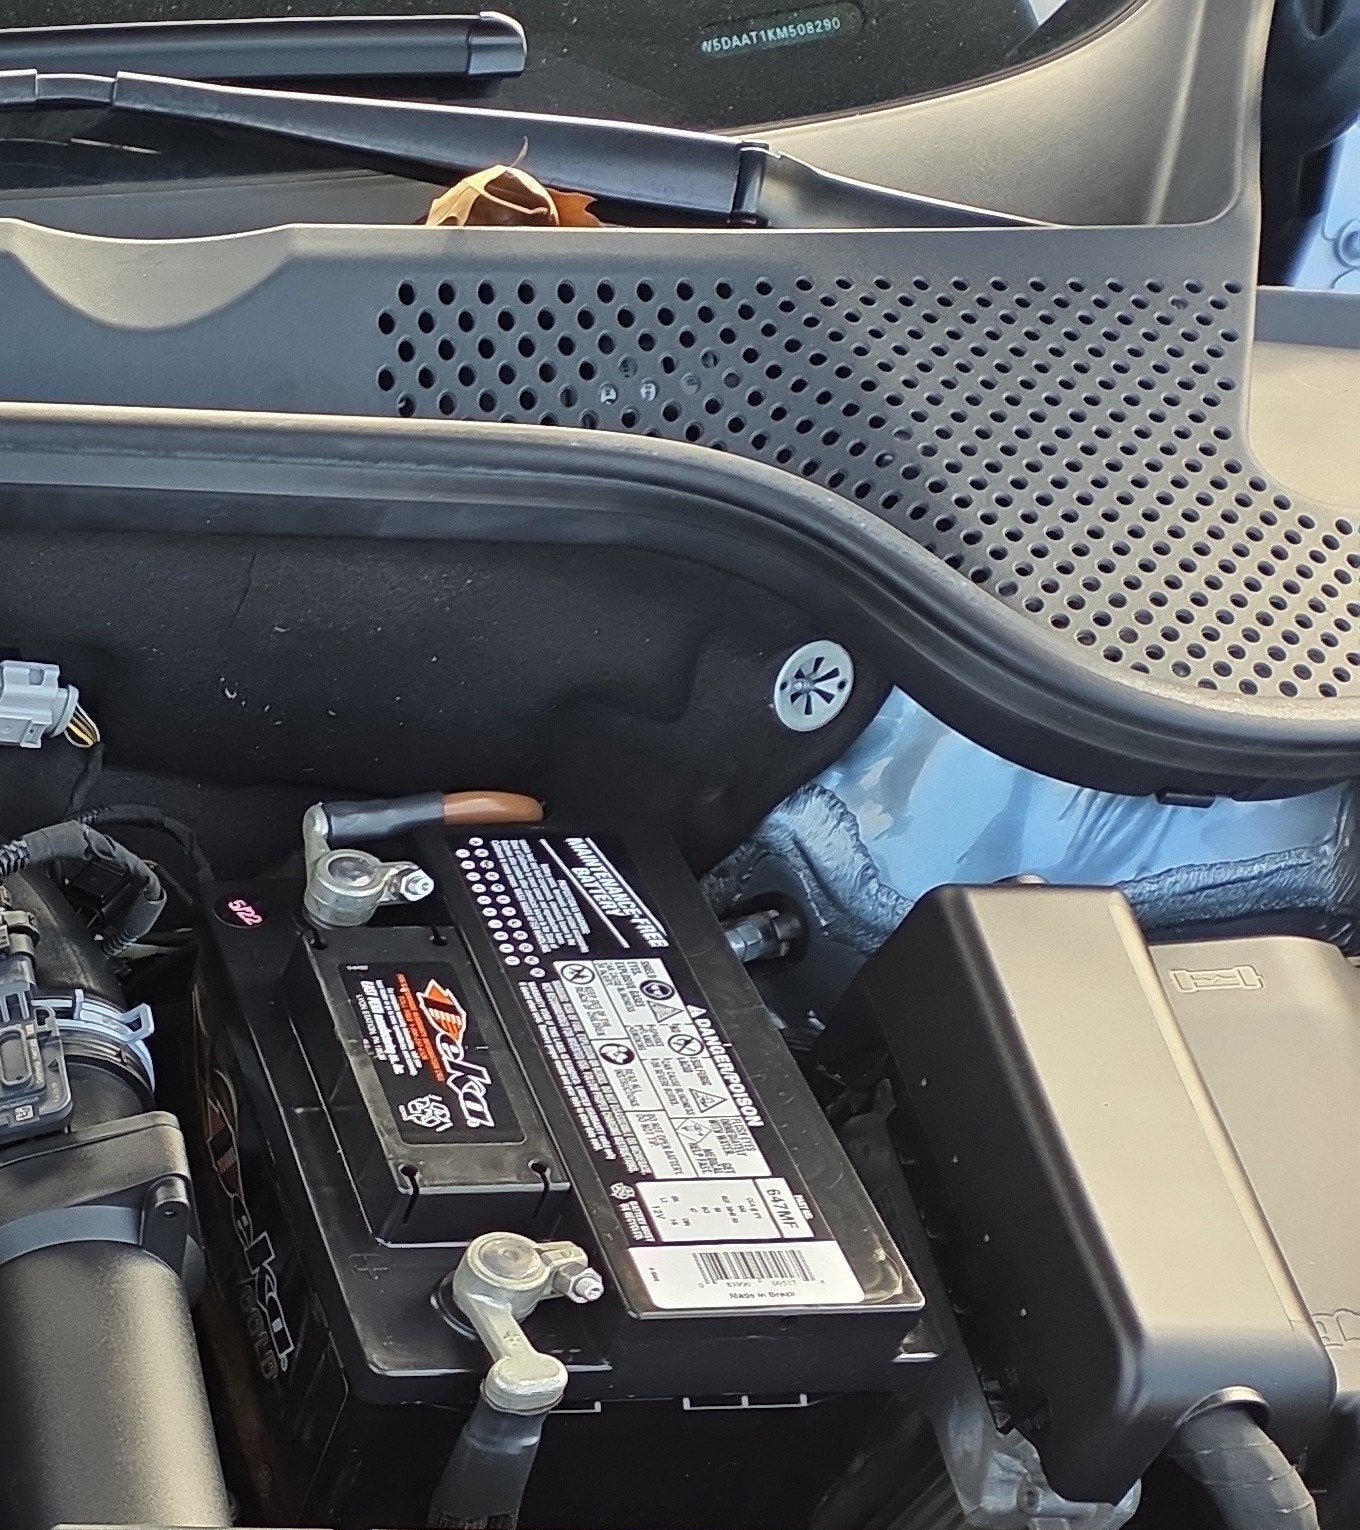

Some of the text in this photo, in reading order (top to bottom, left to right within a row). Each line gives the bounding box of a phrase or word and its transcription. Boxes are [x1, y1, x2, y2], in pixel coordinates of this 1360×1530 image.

[227, 899, 263, 926] 5/22
[565, 838, 670, 948] MAINTENANCE-FREE
[571, 868, 627, 916] BATTERY
[694, 1019, 765, 1126] DANGER/POISON
[651, 1205, 665, 1220] 12V
[765, 1189, 800, 1230] 647MF
